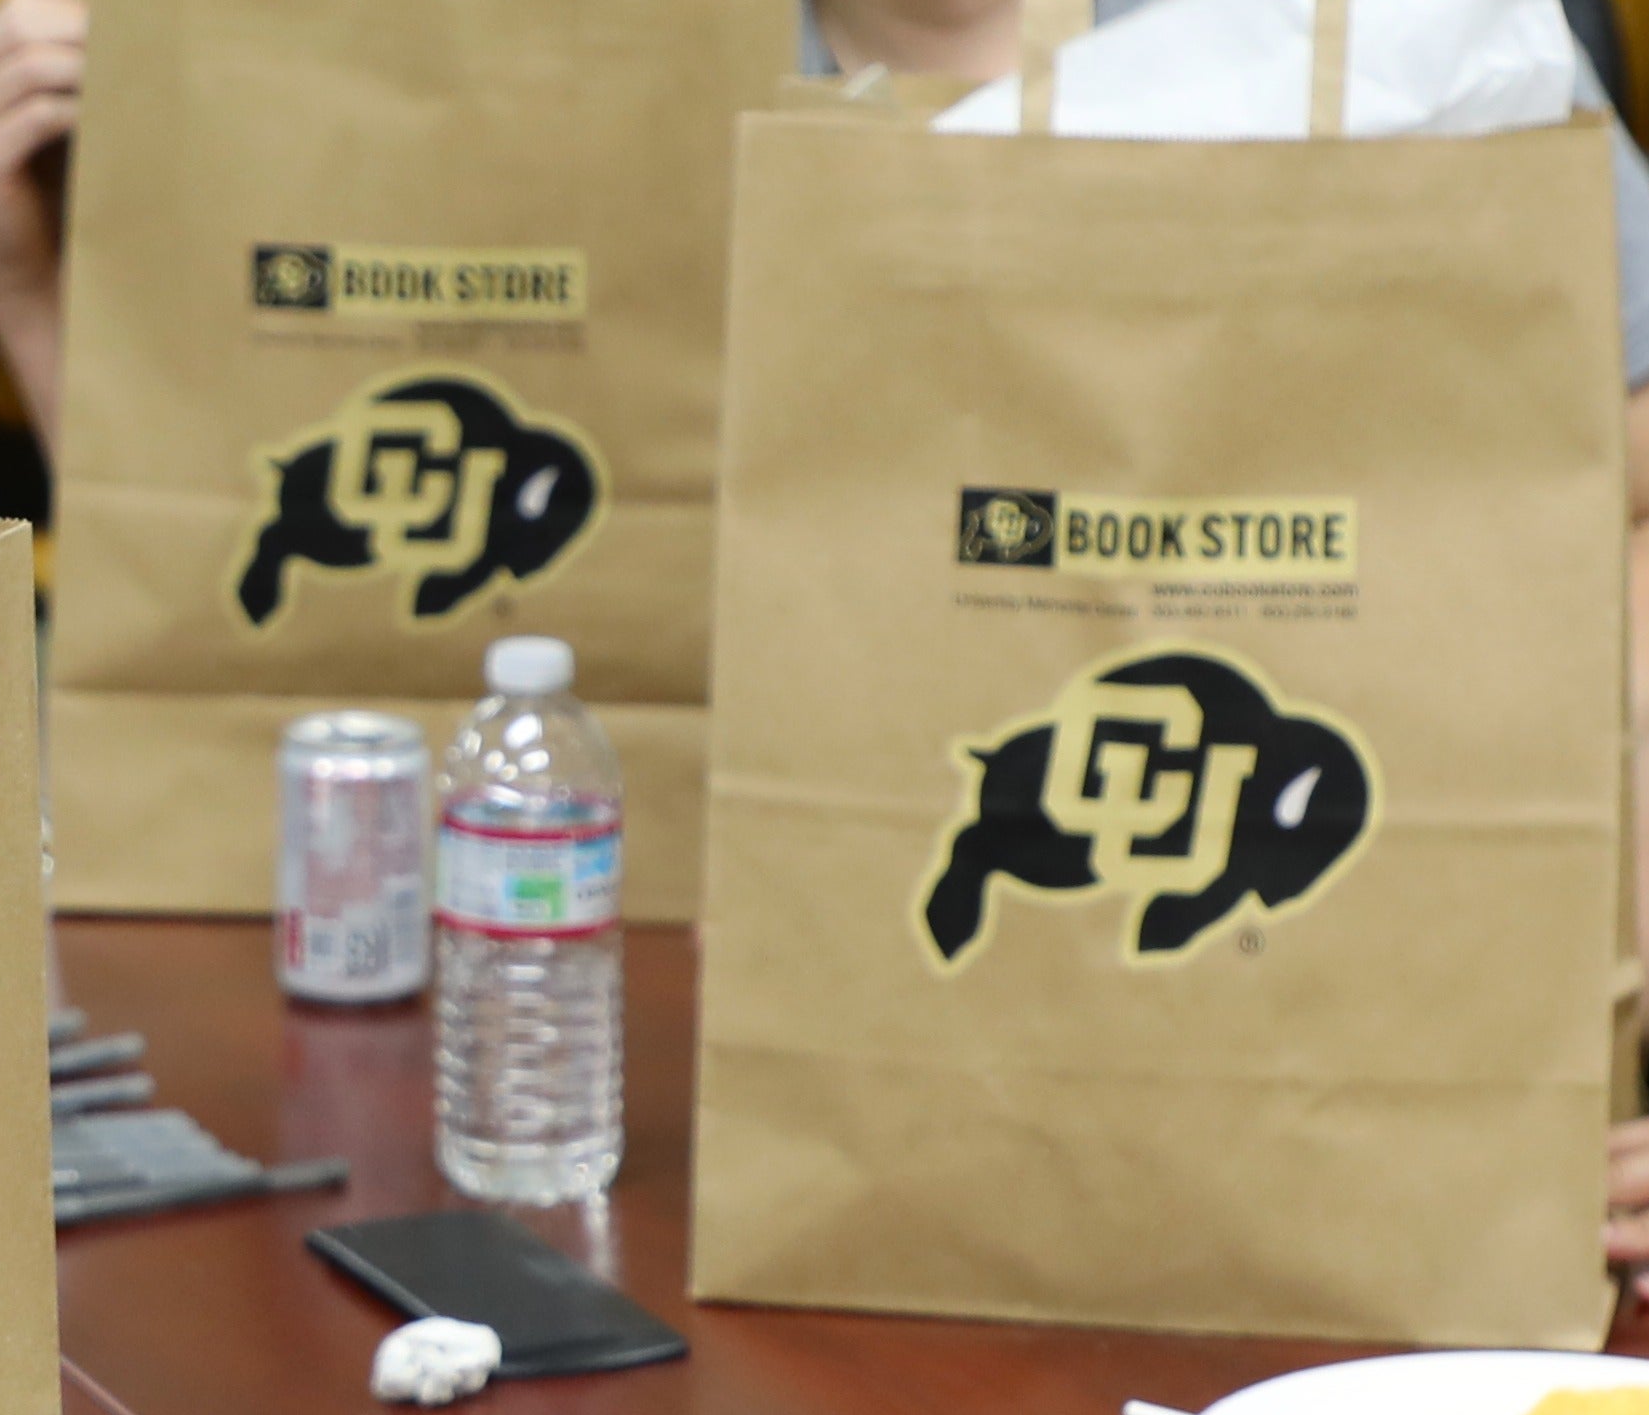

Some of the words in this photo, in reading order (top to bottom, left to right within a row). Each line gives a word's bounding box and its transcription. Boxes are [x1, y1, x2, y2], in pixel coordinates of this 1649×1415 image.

[343, 261, 444, 301] BOOK
[454, 262, 573, 305] STORE
[1067, 511, 1186, 559] BOOK
[1200, 512, 1347, 561] STORE
